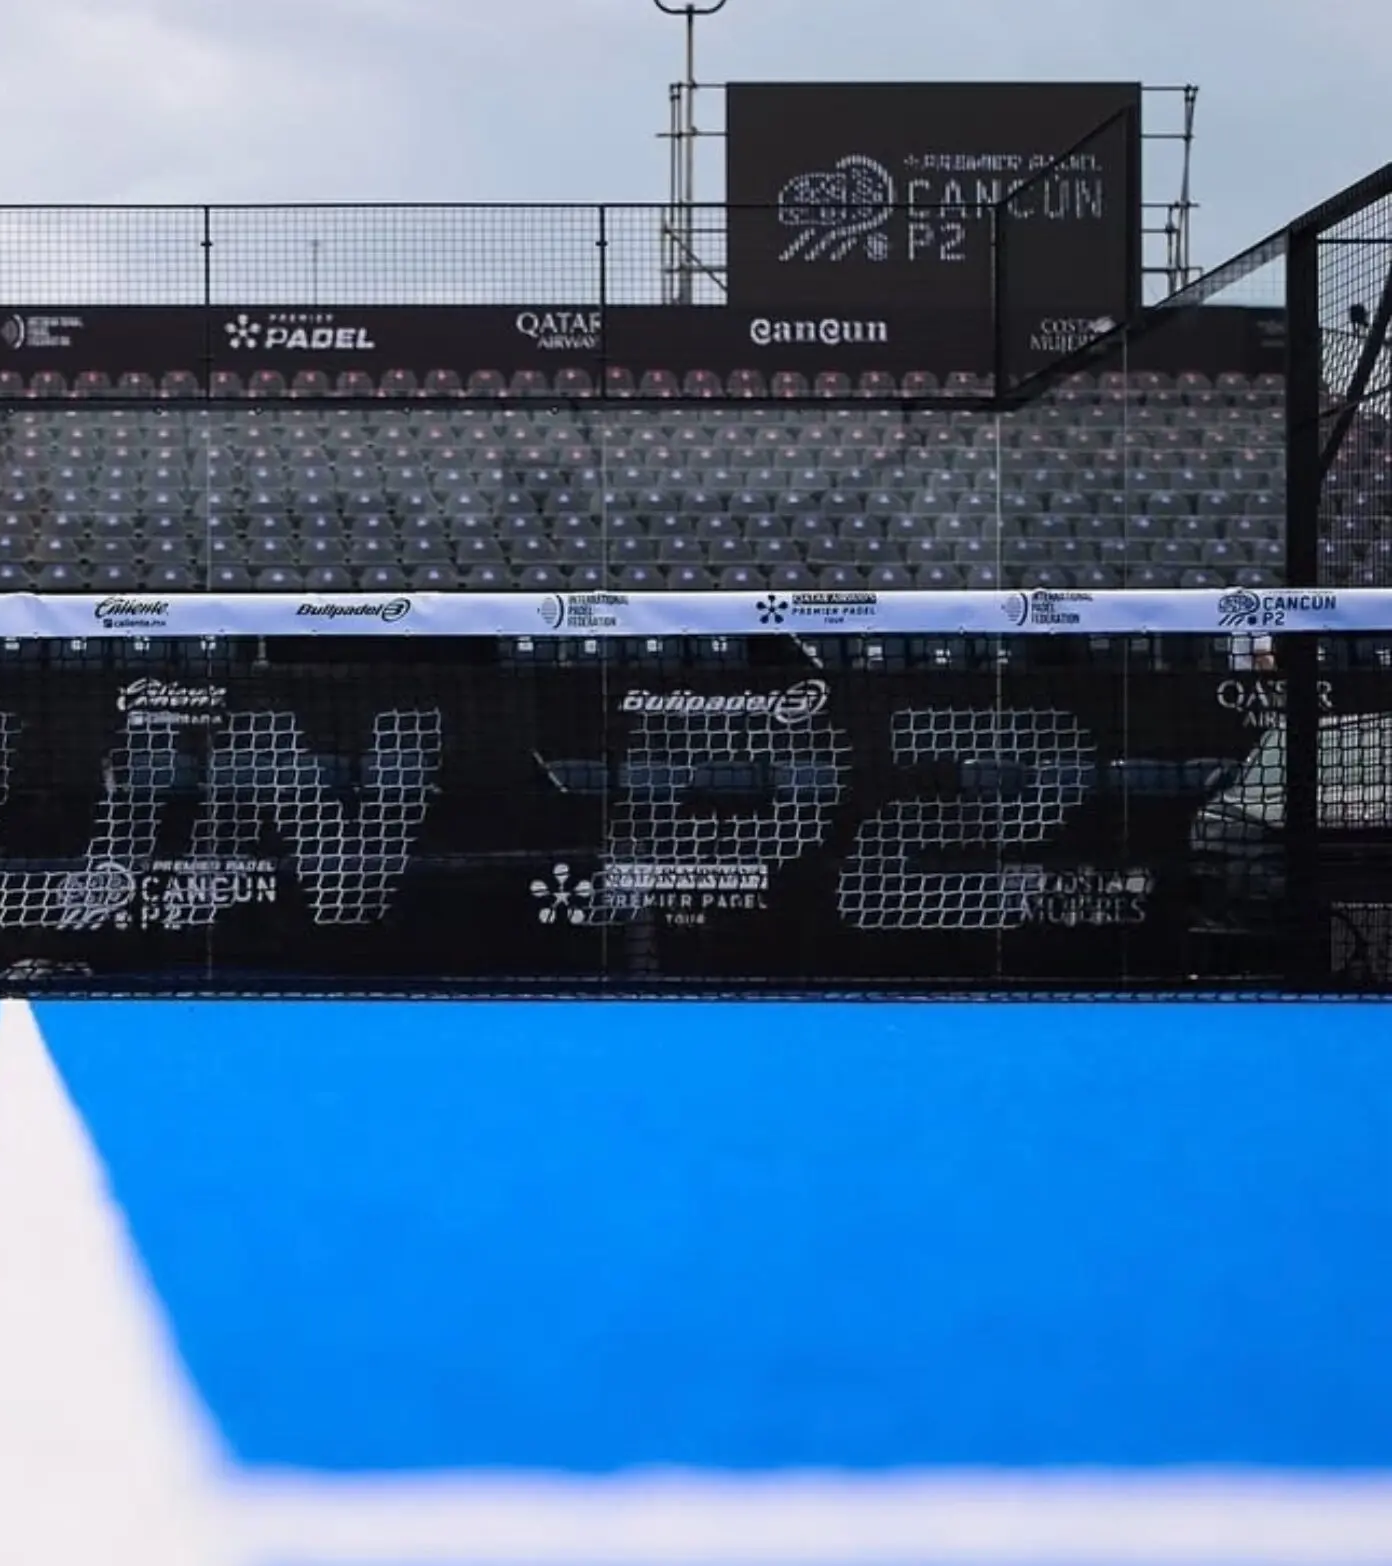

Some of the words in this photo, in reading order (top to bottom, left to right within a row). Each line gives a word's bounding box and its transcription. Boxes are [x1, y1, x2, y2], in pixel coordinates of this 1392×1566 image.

[908, 222, 965, 261] P2
[265, 327, 376, 349] PADEL
[296, 604, 385, 620] Bullpadel
[1263, 612, 1285, 626] P2
